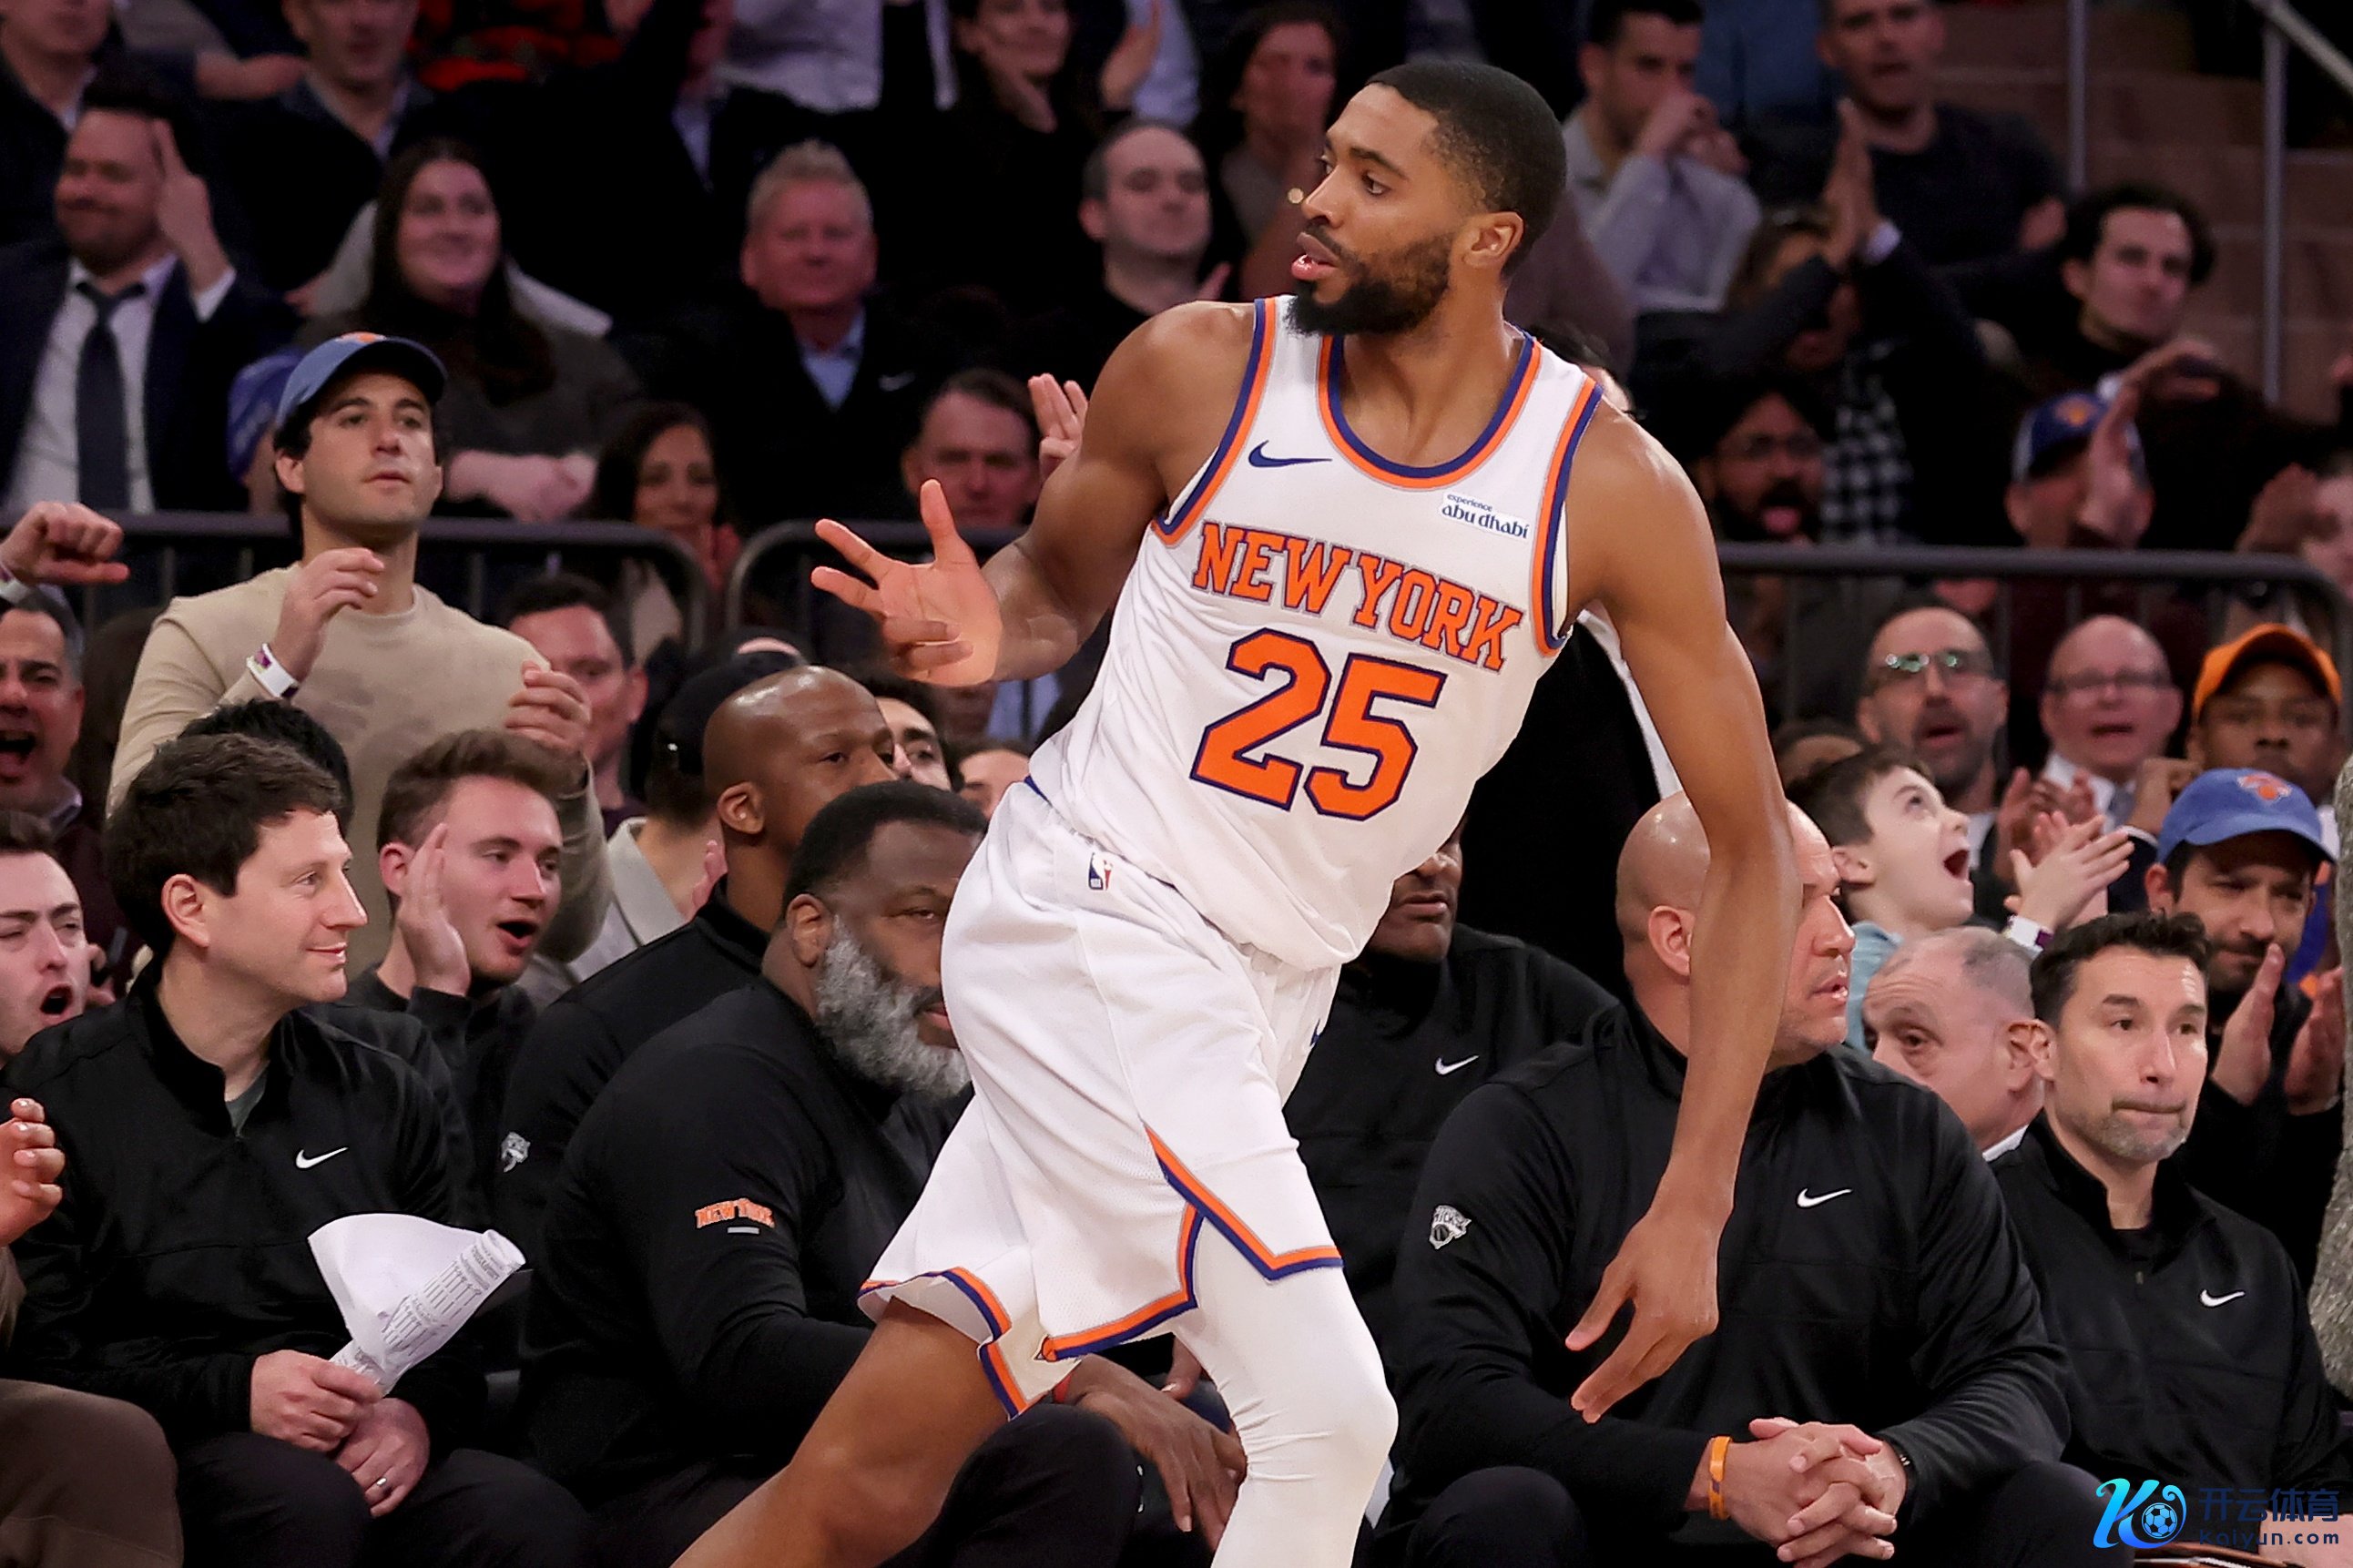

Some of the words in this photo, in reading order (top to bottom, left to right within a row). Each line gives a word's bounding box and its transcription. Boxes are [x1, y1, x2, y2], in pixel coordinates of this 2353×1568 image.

[1441, 504, 1476, 524] abu
[1478, 514, 1530, 539] dhabi
[1446, 494, 1493, 512] experience
[1191, 521, 1354, 616] NEW
[1350, 551, 1524, 674] YORK
[1189, 627, 1447, 821] 25
